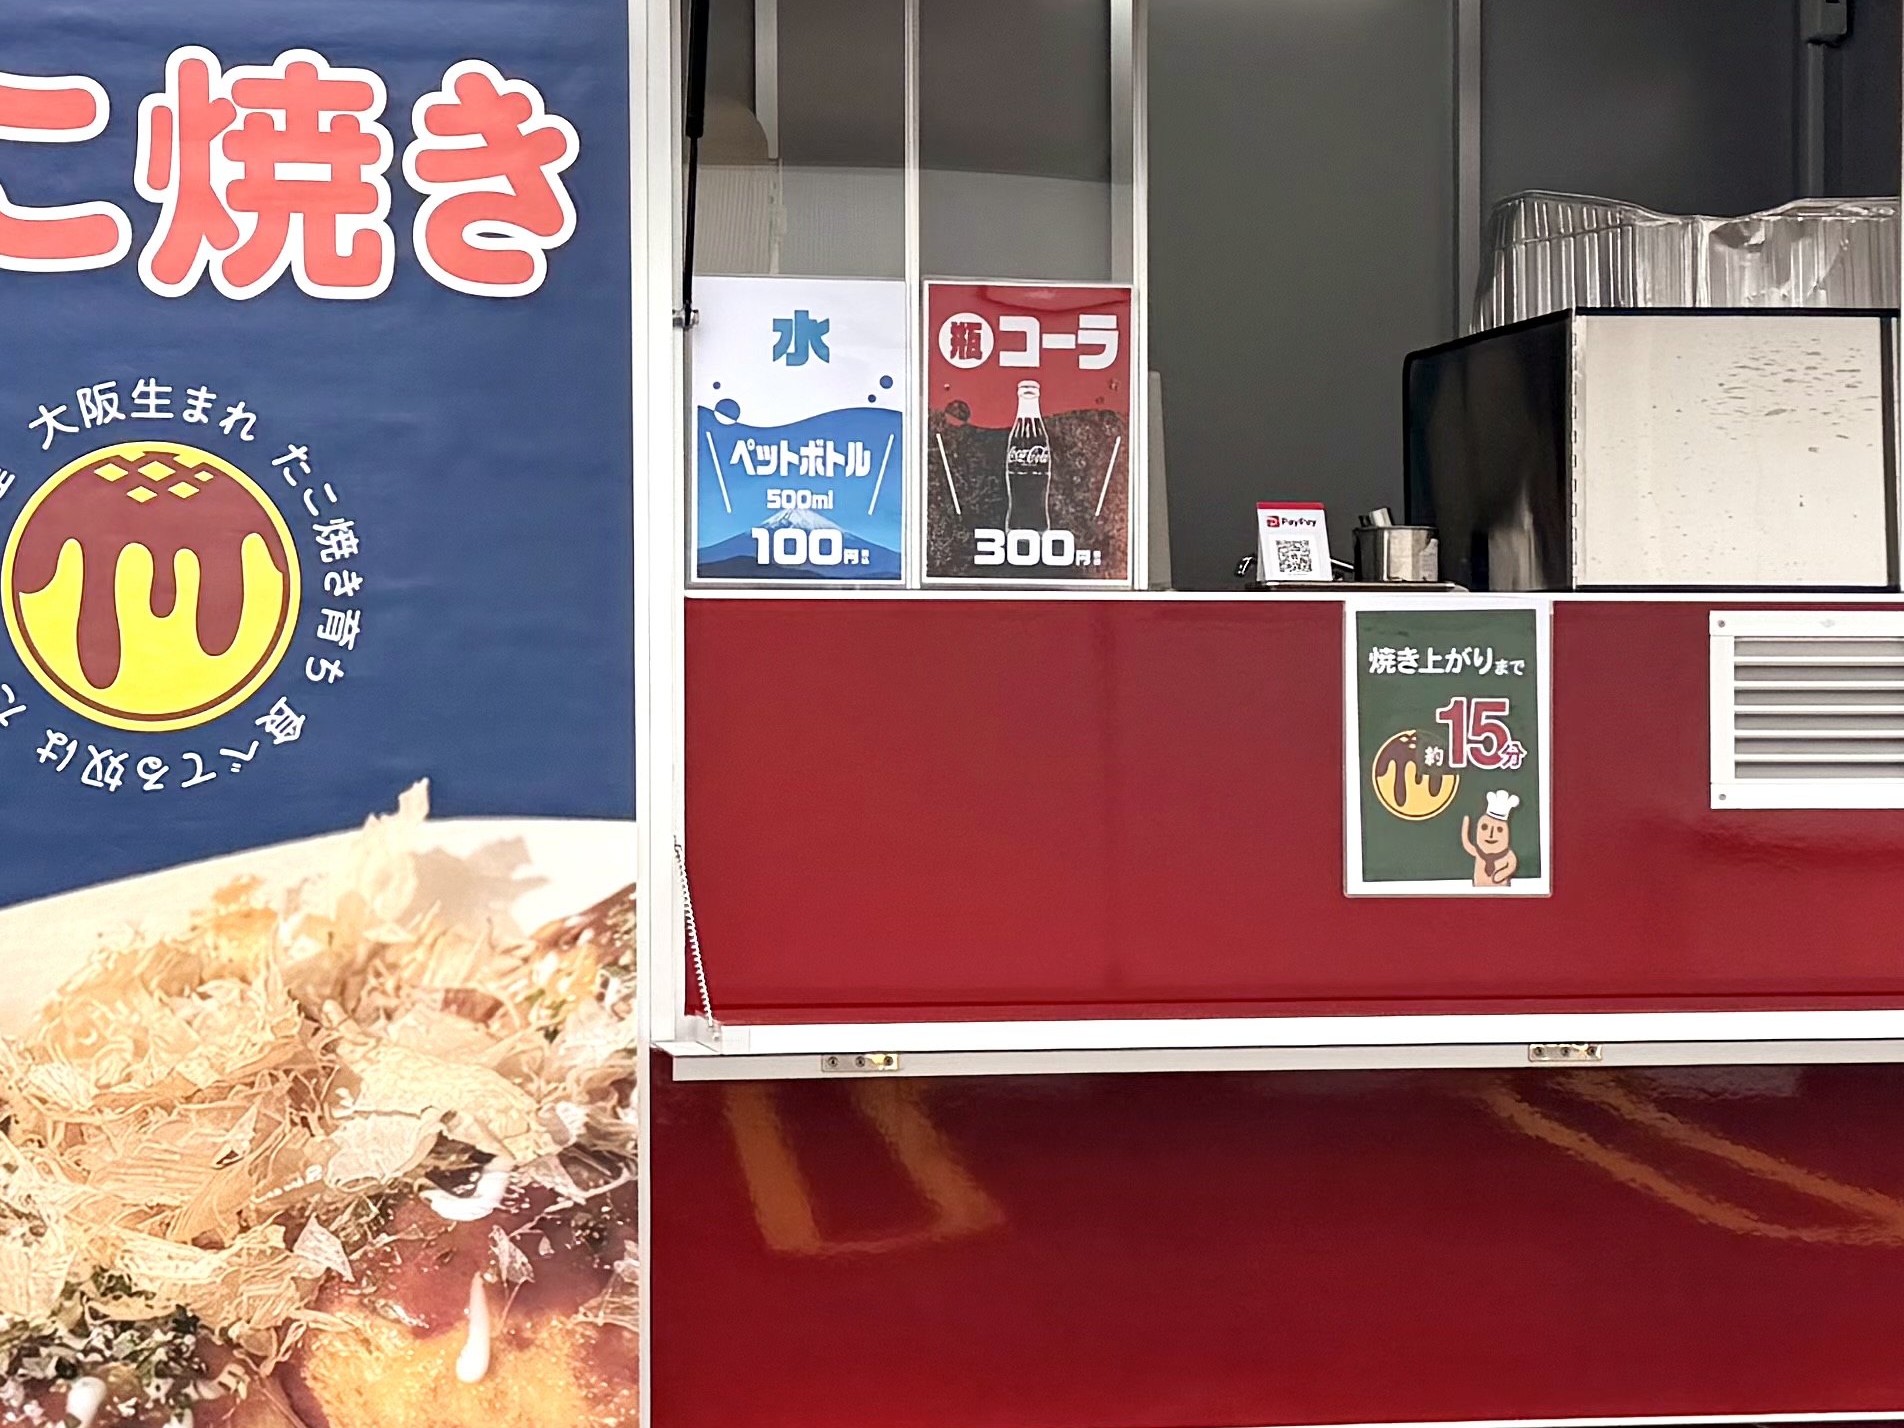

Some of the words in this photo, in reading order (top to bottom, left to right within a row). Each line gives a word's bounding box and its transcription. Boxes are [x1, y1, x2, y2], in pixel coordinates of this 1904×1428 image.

[772, 310, 830, 367] 水
[729, 439, 872, 478] ペットボトル
[767, 488, 834, 510] 500ml
[28, 377, 259, 451] 大阪生まれ
[271, 442, 364, 685] たこ焼き育ち
[1368, 646, 1526, 677] 焼き上がりまで
